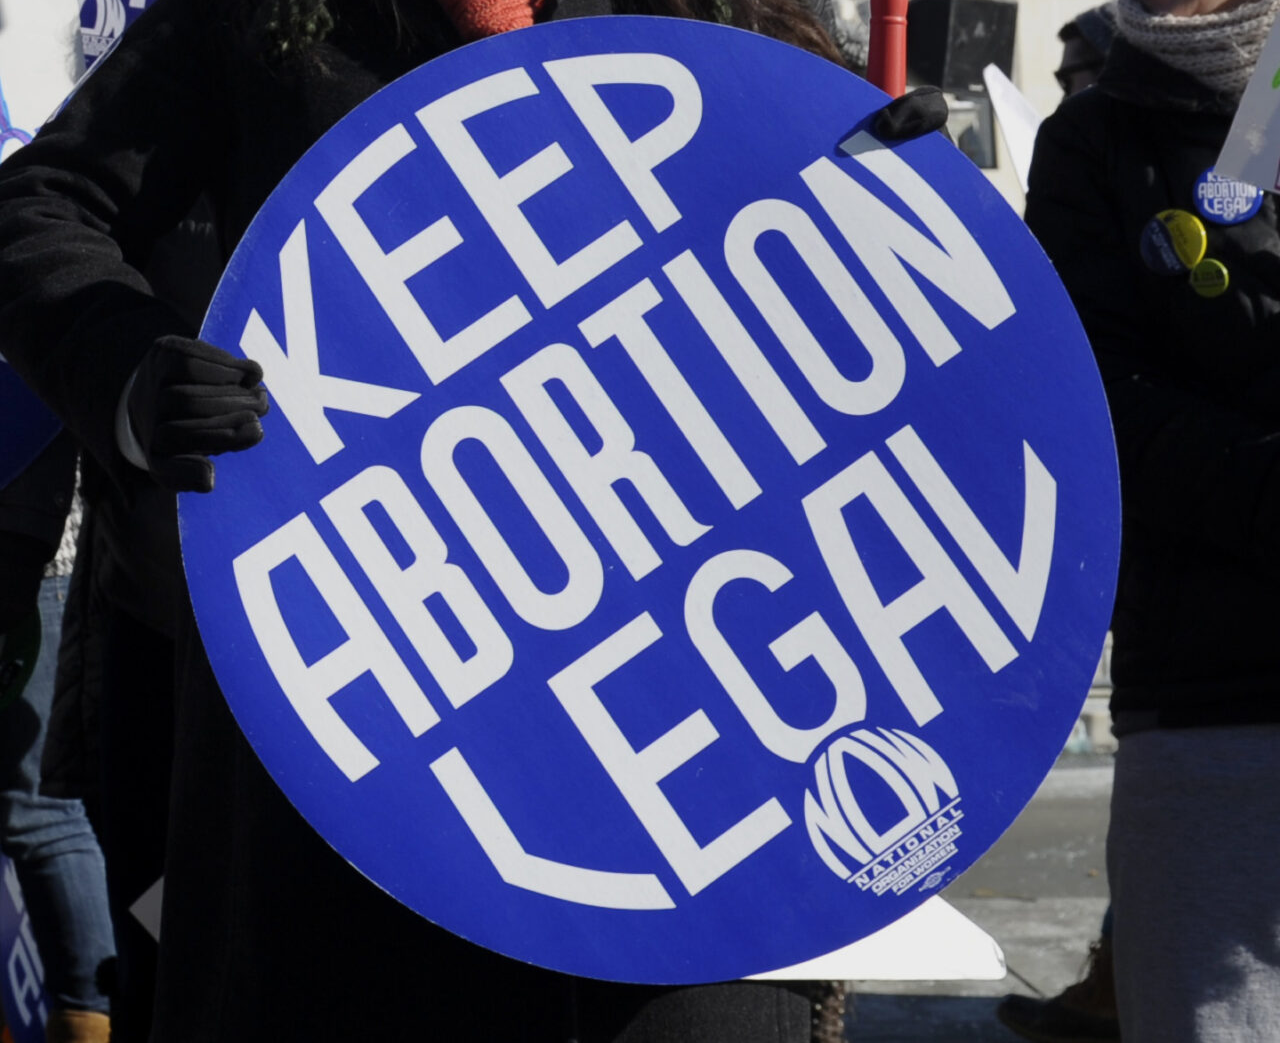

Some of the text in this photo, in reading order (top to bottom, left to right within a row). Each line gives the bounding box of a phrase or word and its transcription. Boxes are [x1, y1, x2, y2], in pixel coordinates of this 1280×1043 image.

[238, 52, 702, 465] KEEP
[1204, 198, 1252, 214] LEGAL
[233, 130, 1017, 783] ABORTION
[428, 423, 1058, 910] LEGAL
[804, 726, 959, 880] NOW
[854, 808, 962, 889] NATIONAL
[871, 824, 960, 894] ORGANIZATION
[891, 843, 956, 893] FOR WOMEN
